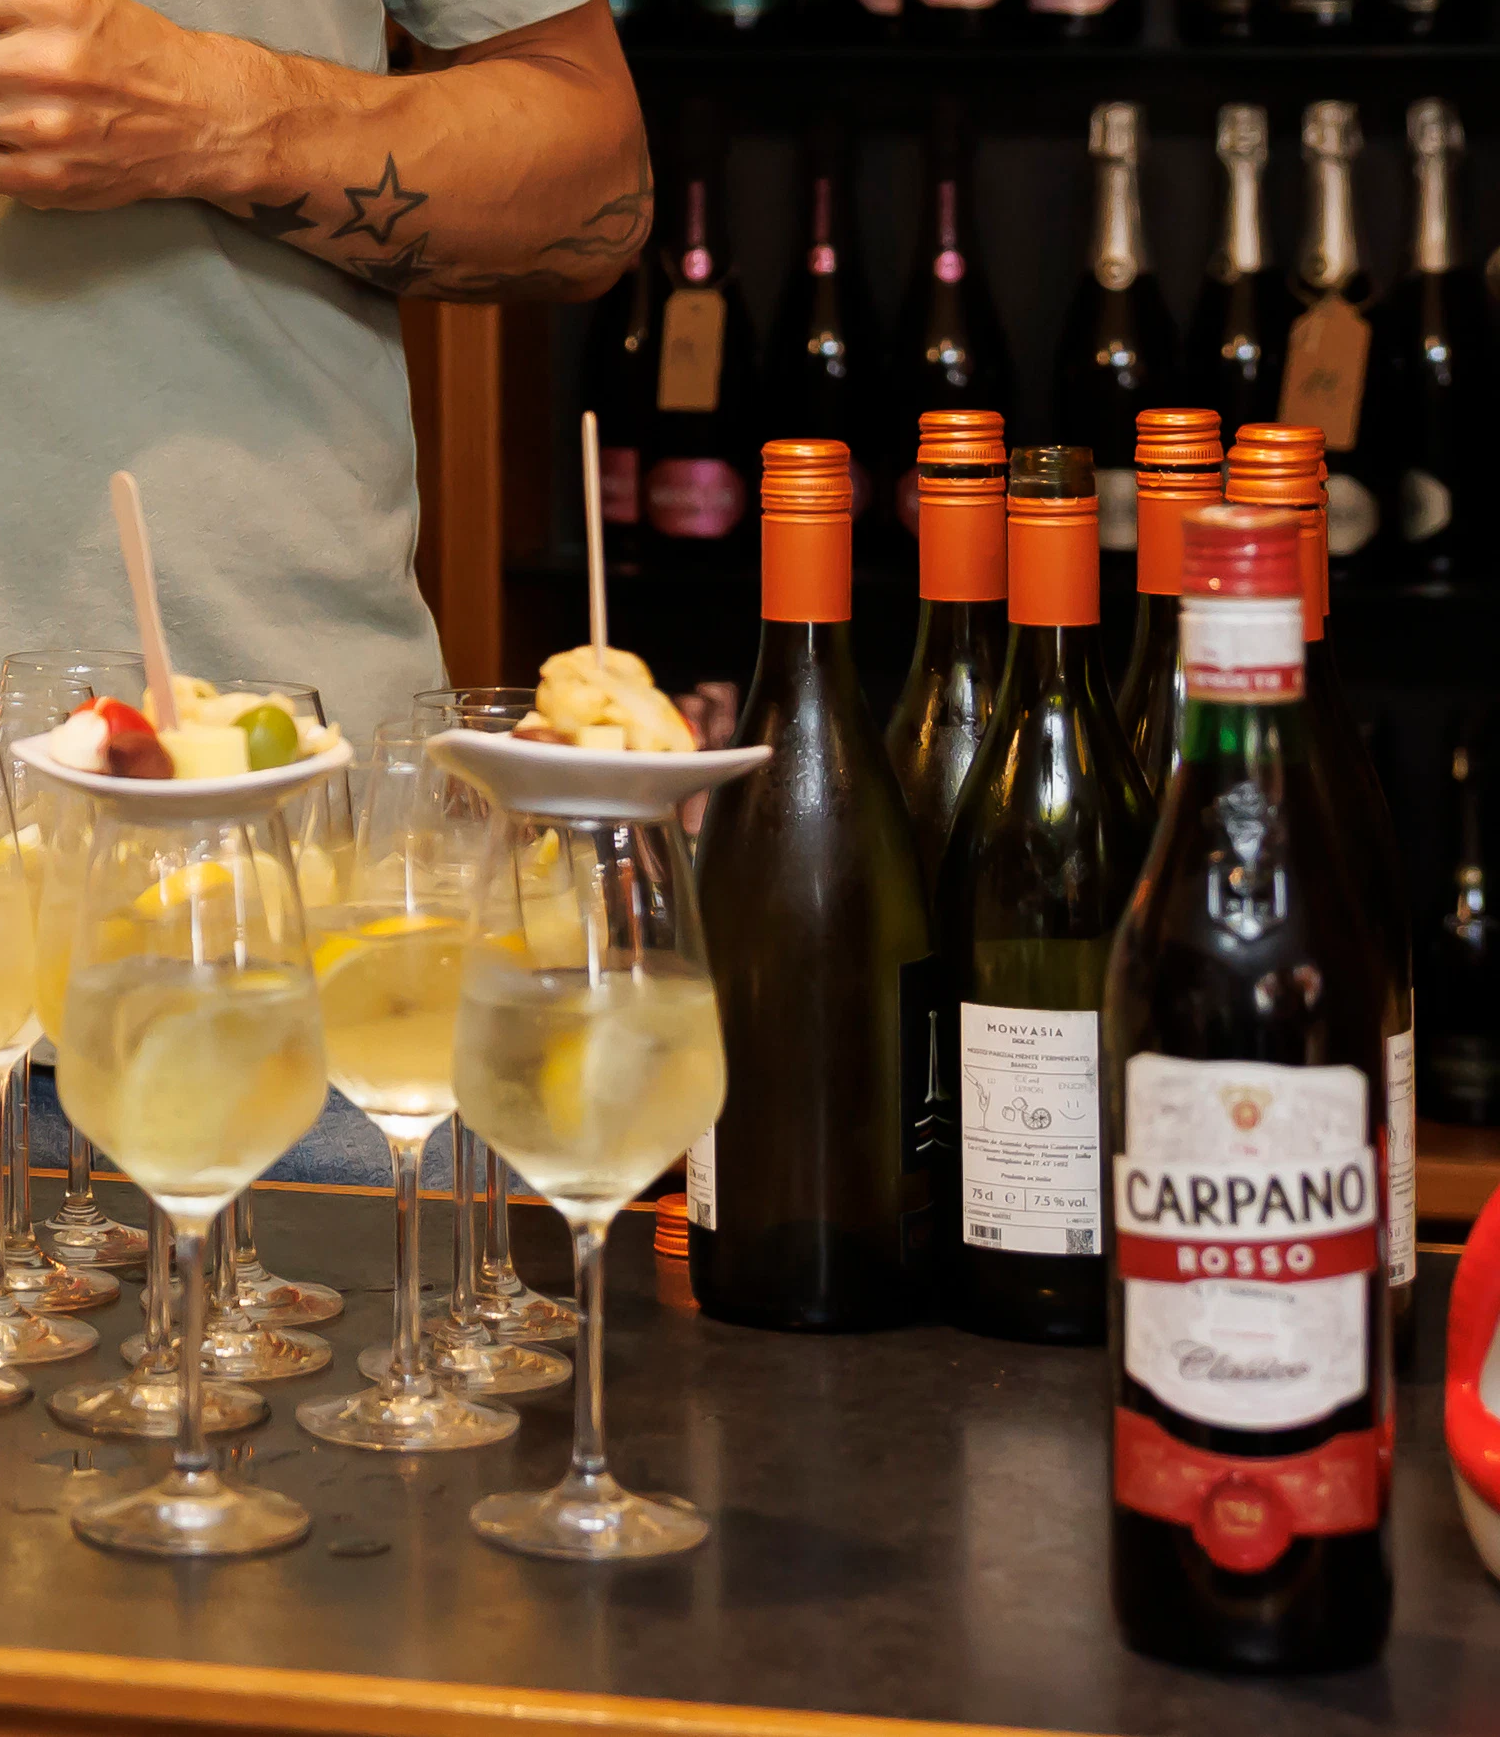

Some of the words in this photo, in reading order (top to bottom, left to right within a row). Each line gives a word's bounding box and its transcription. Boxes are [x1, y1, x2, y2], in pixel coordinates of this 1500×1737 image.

[987, 1023, 1064, 1037] MONVASIA
[972, 1188, 983, 1199] 75
[1125, 1163, 1367, 1226] CARPANO
[1068, 1197, 1088, 1207] vol.
[1177, 1243, 1315, 1276] ROSSO
